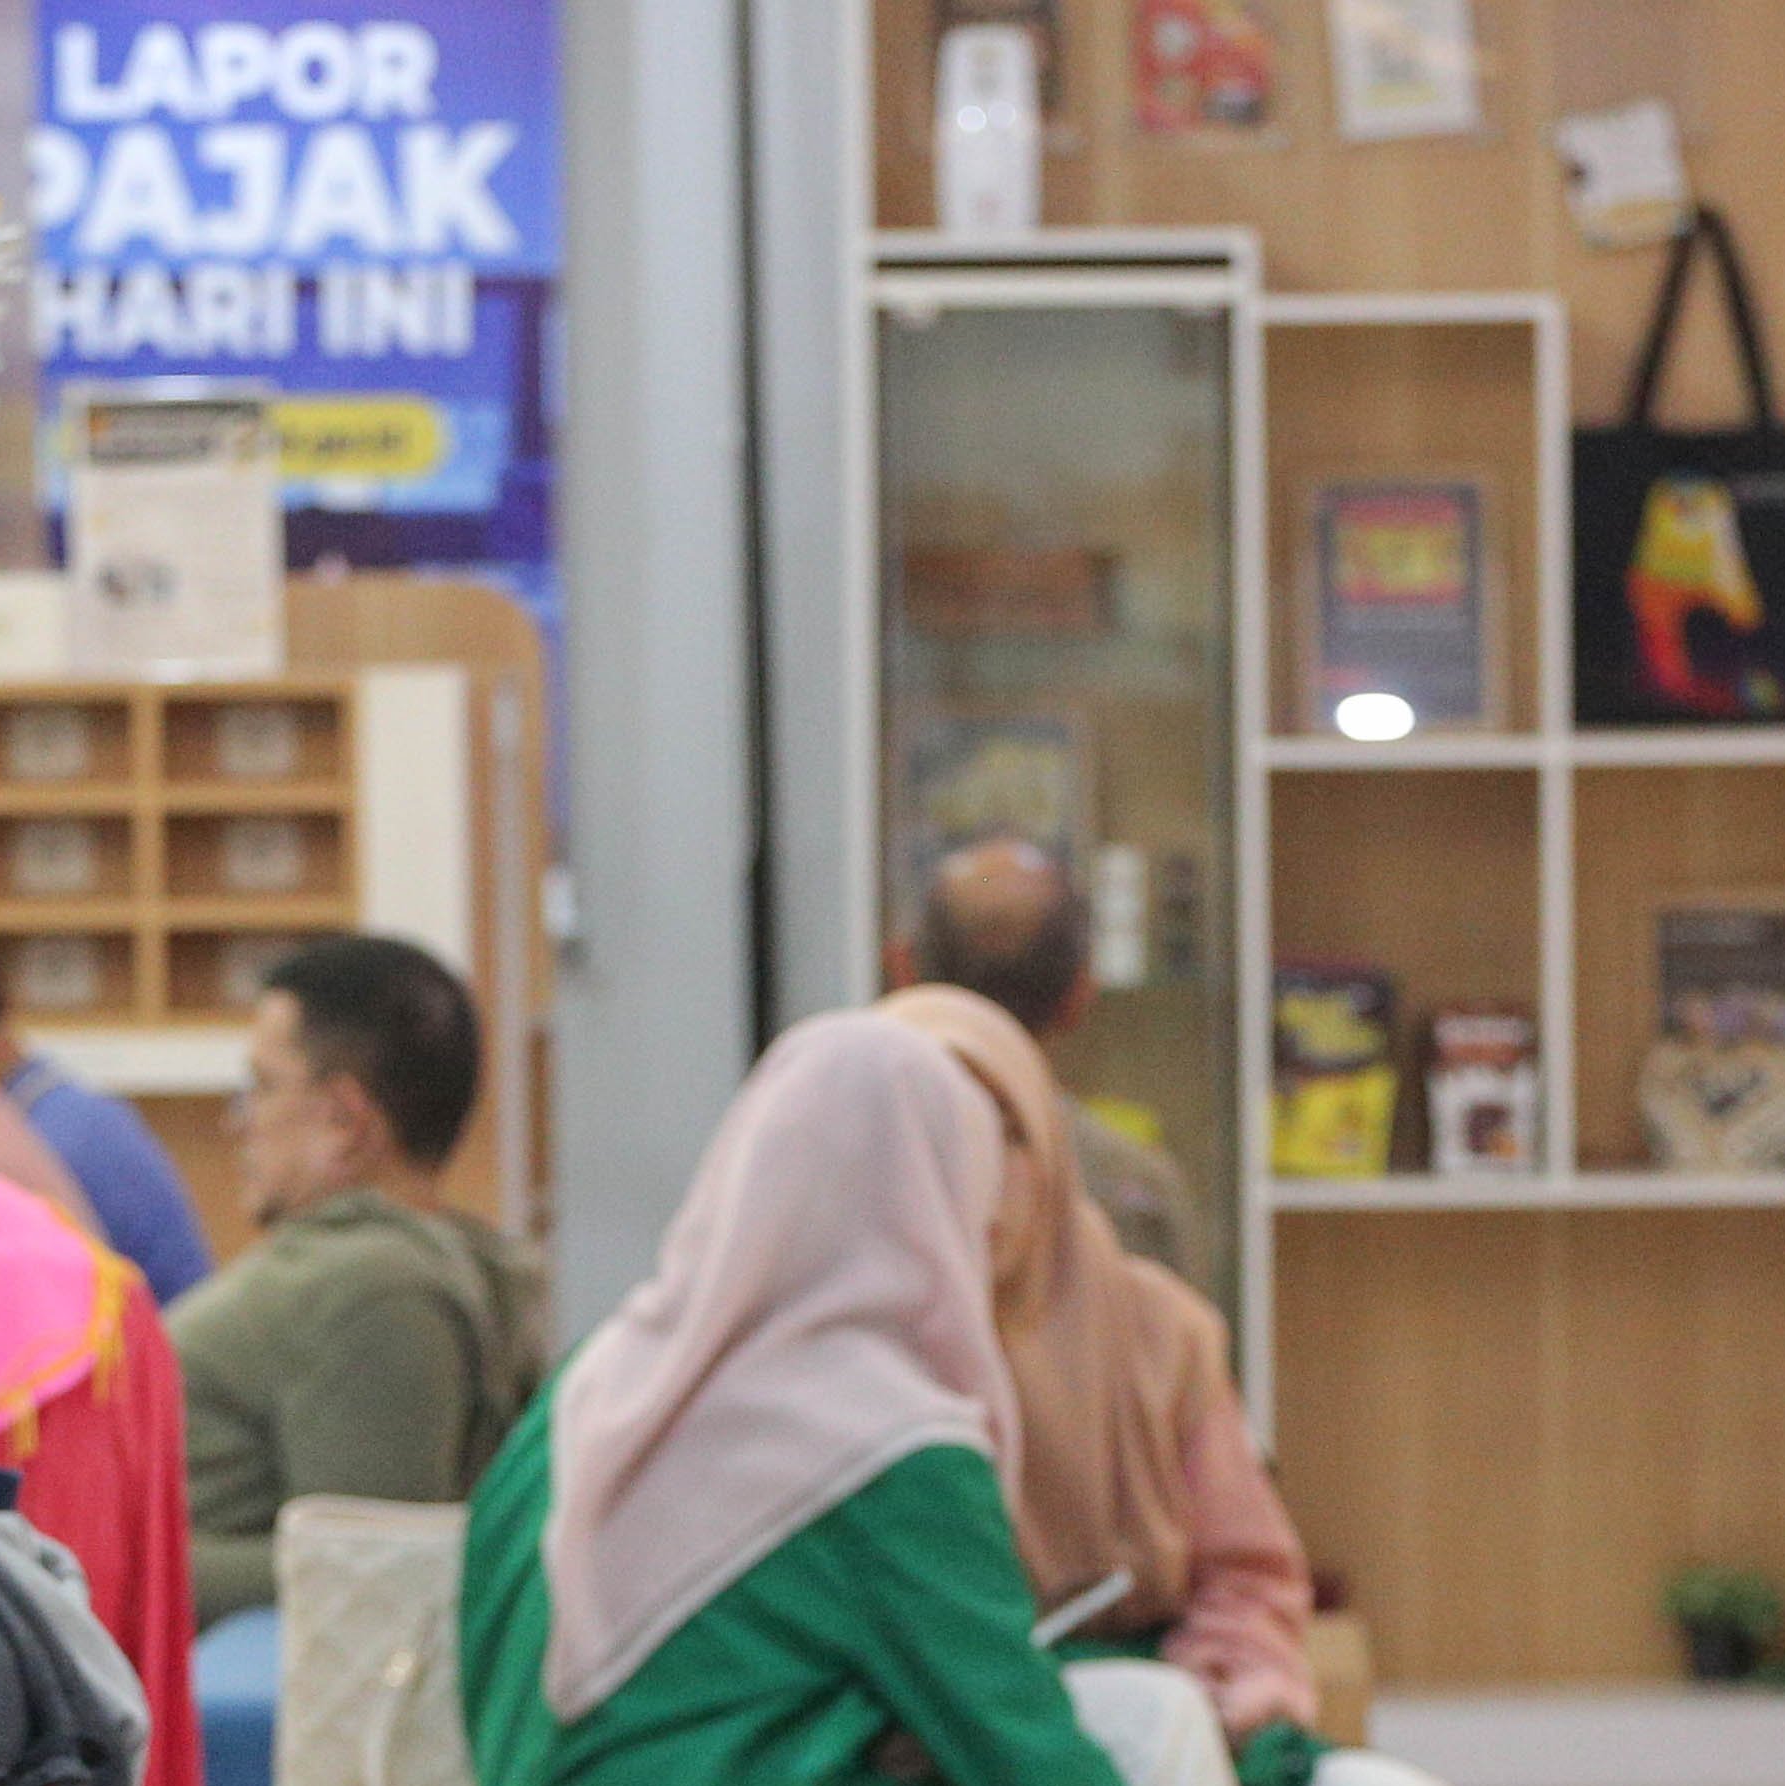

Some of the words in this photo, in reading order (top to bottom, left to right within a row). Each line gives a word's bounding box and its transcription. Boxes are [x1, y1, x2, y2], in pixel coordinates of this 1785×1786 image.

[53, 22, 438, 119] LAPOR
[25, 122, 518, 256] PAJAK
[30, 262, 298, 358] HARI
[318, 262, 477, 358] INI
